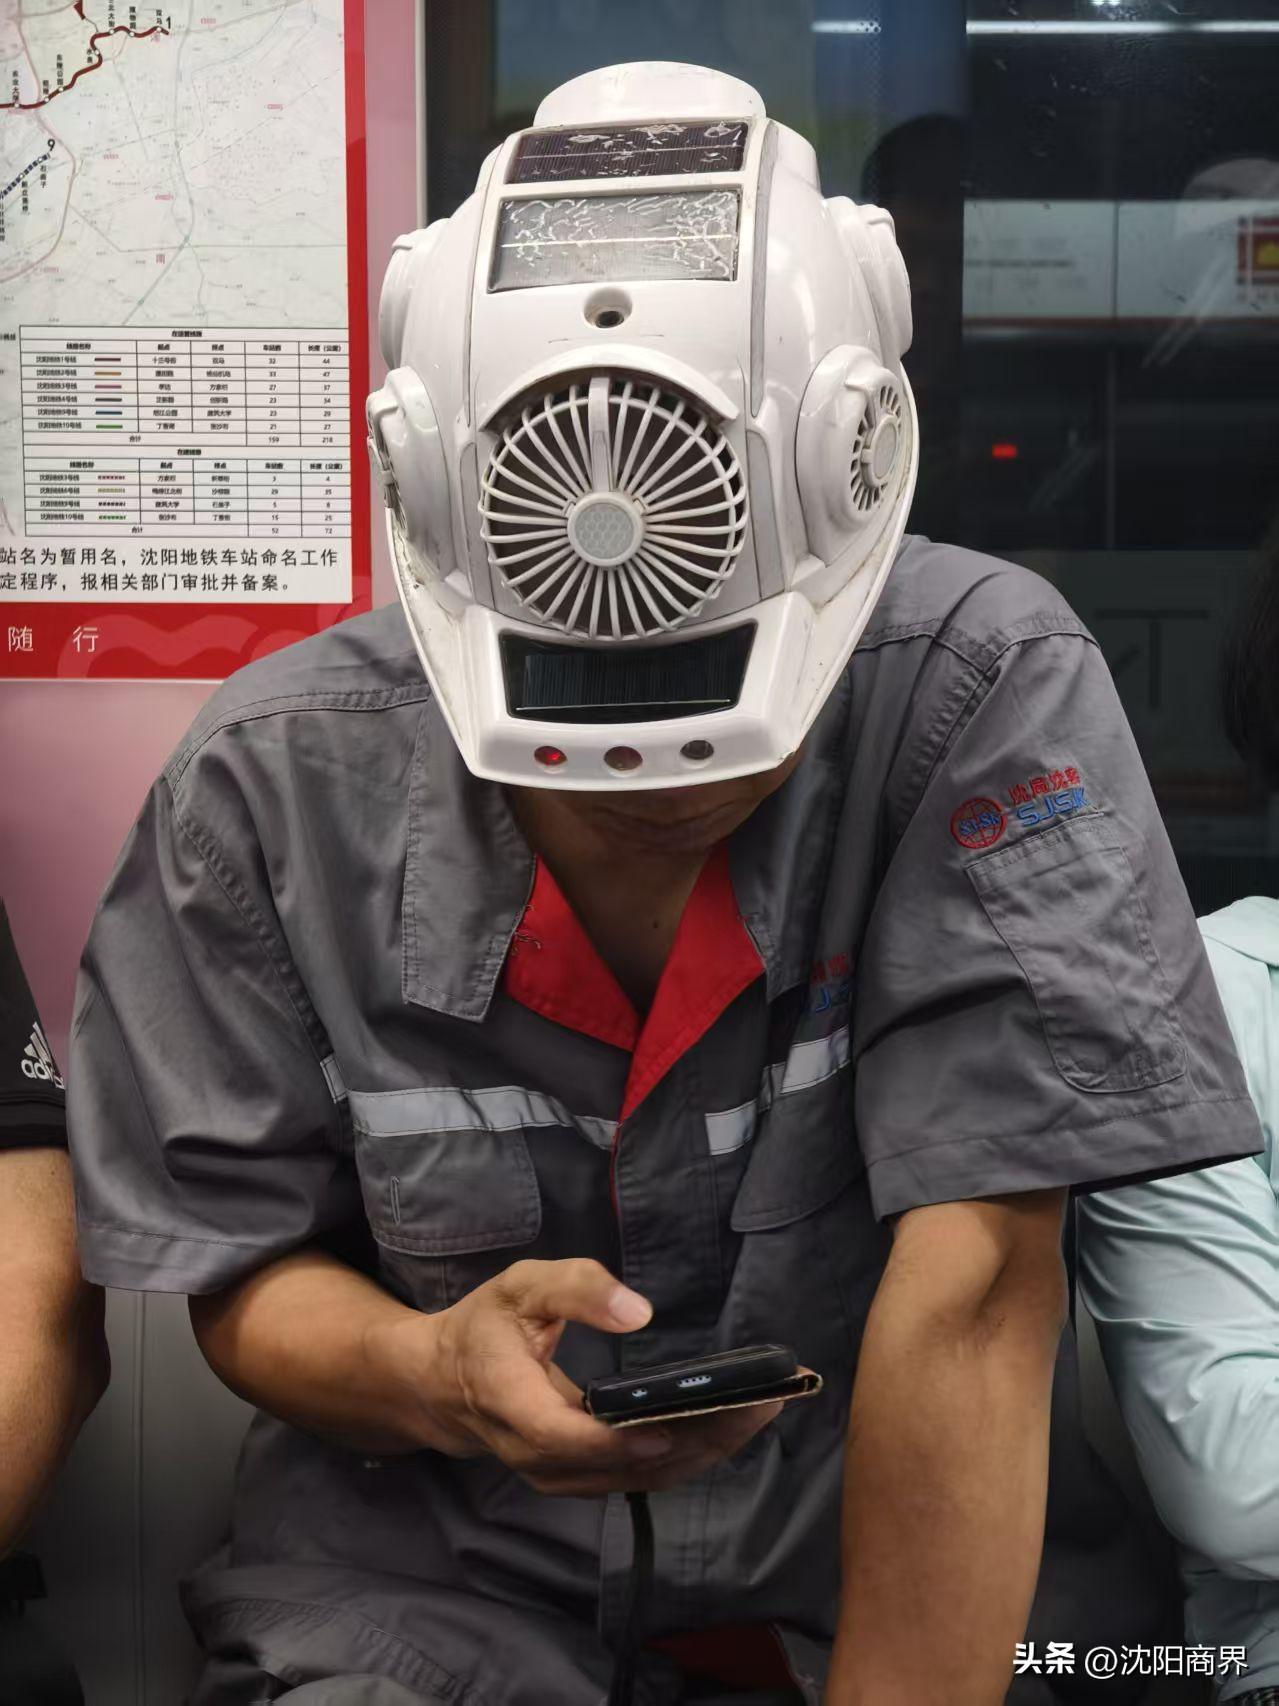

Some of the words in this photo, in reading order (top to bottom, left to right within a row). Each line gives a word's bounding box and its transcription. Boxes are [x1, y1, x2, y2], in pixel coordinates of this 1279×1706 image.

[165, 16, 172, 30] 1
[47, 138, 56, 152] 9
[0, 547, 338, 567] 站名为暂用名，沈阳地铁车站命名工作
[0, 572, 291, 592] 定程序，报相关部门审批并备案。
[1016, 787, 1088, 827] SJSK
